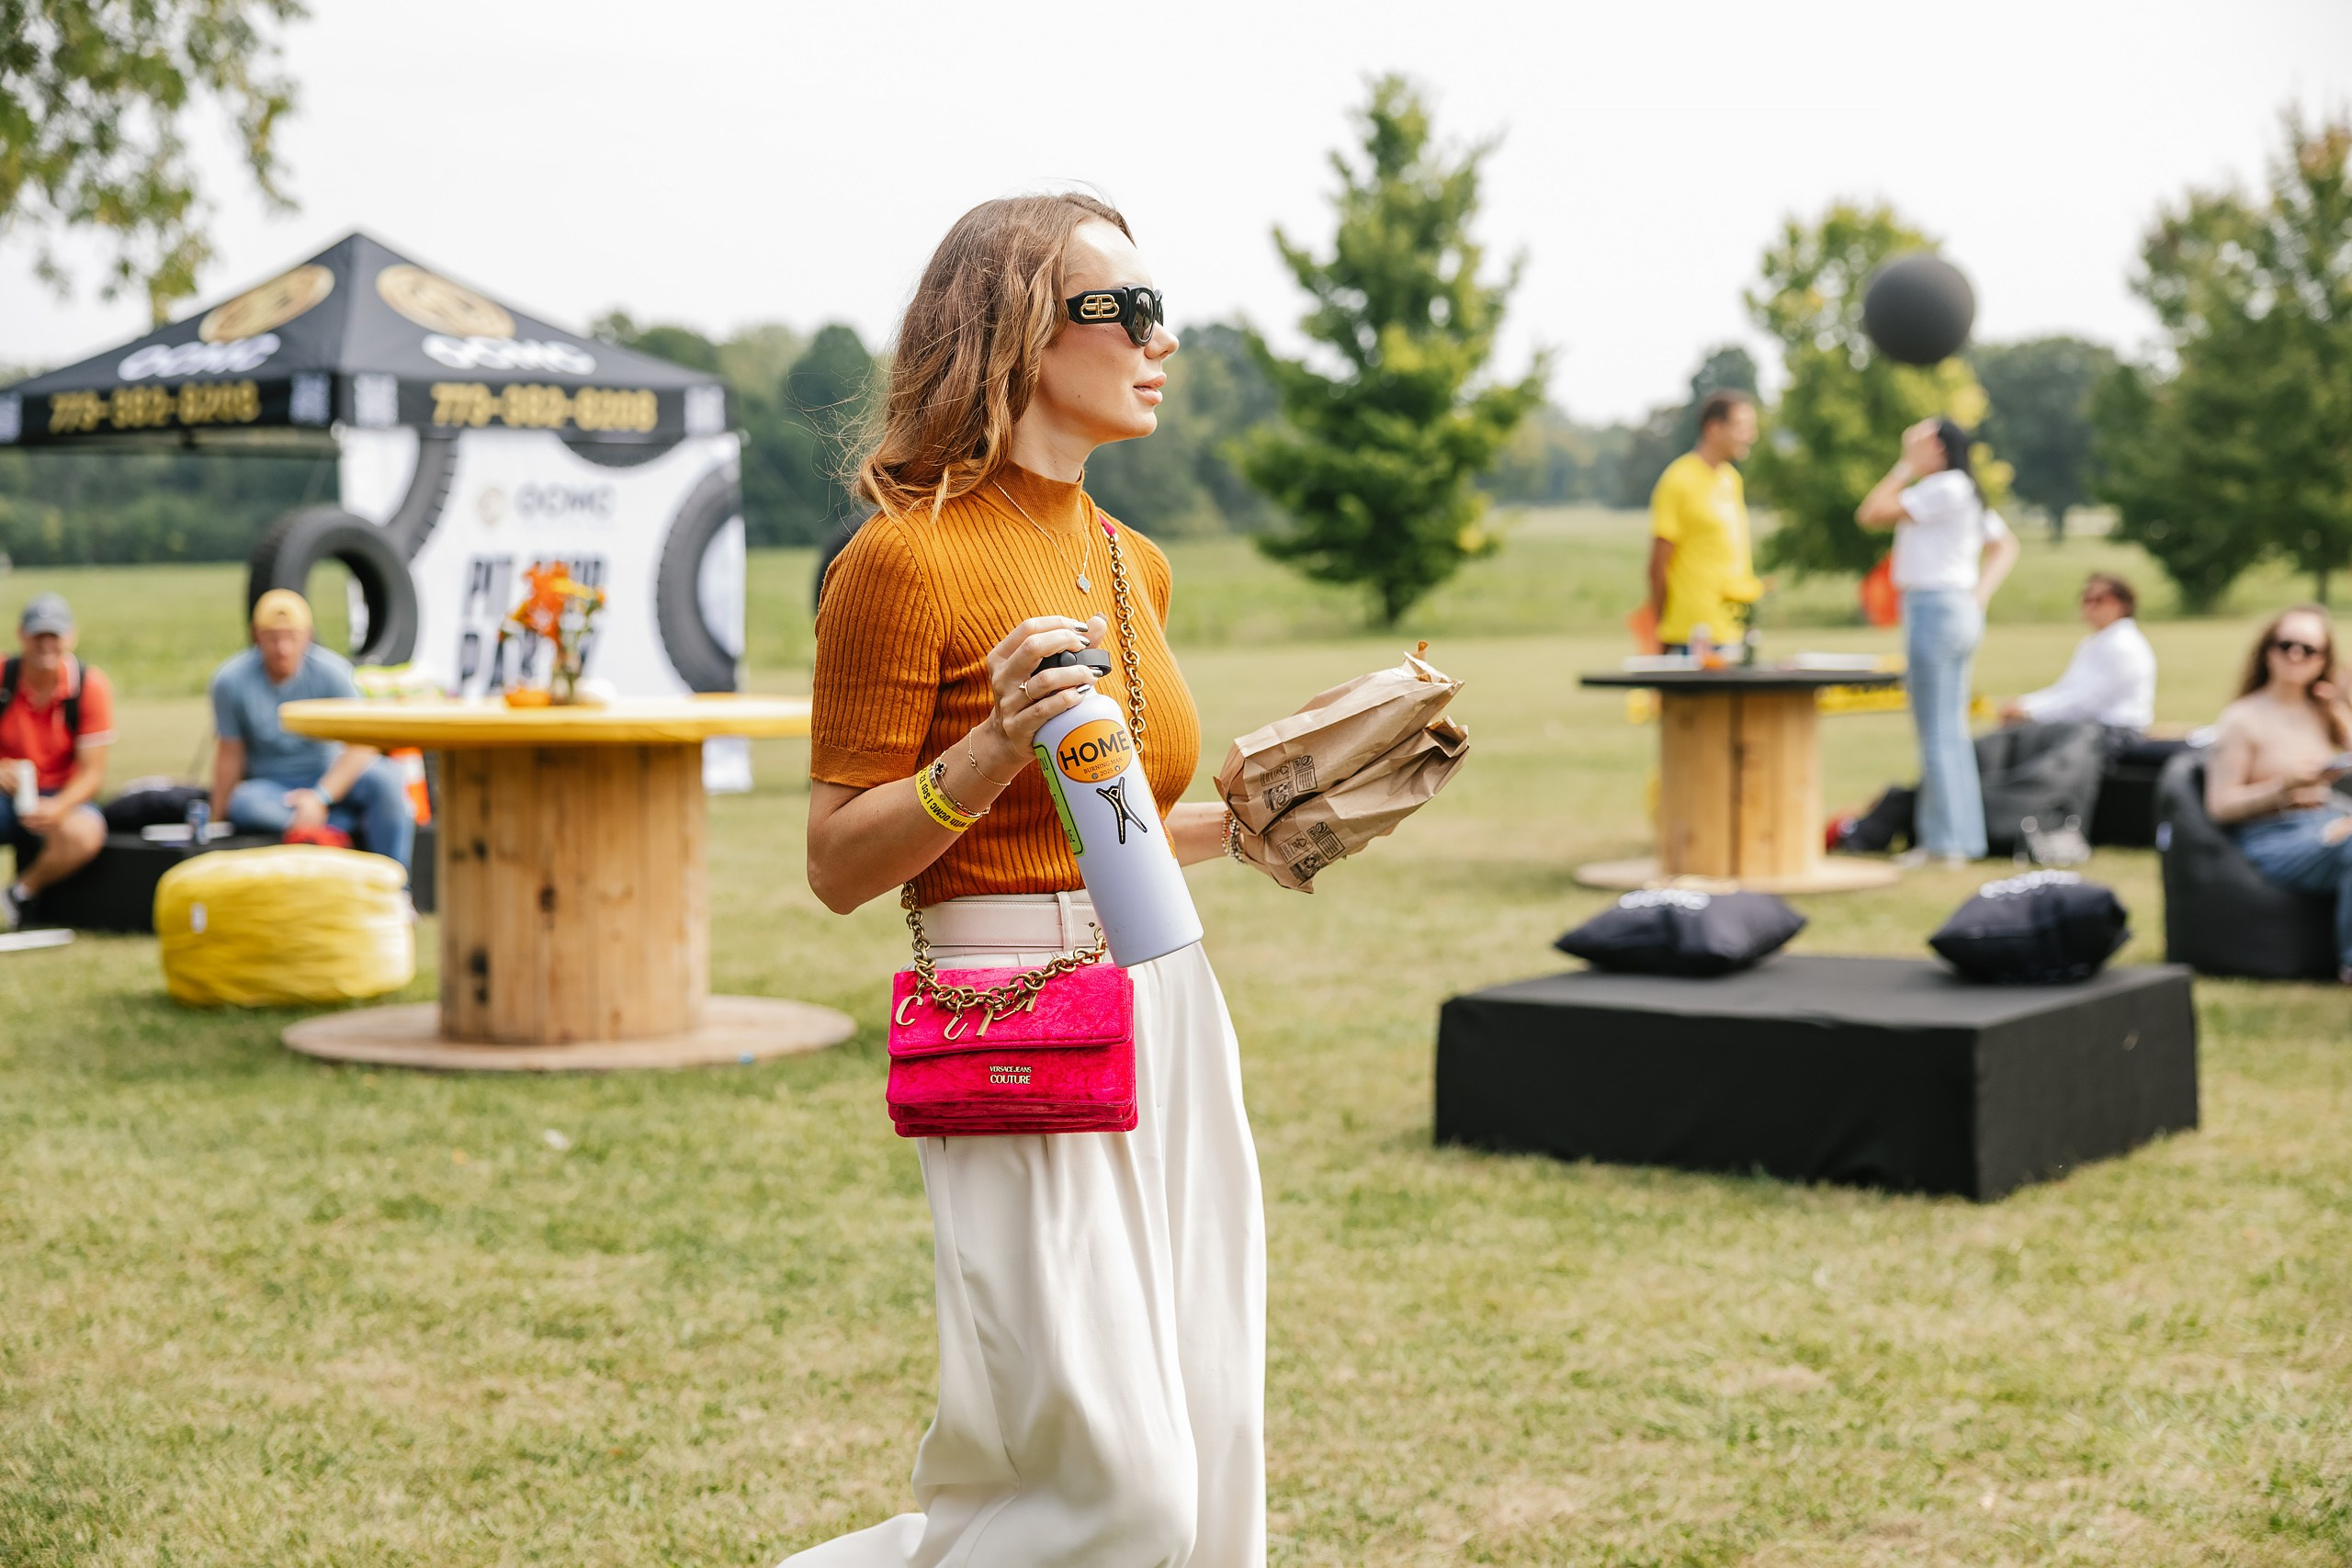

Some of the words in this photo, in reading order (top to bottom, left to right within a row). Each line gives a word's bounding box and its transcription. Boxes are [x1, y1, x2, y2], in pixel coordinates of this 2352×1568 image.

[1059, 730, 1130, 770] HOME
[1083, 761, 1110, 774] BURNING
[1109, 757, 1123, 767] MAN
[1100, 768, 1114, 776] 2025
[922, 784, 931, 799] Sep
[930, 803, 951, 822] OCMC
[950, 818, 967, 829] with
[989, 1074, 1031, 1084] COUTURE
